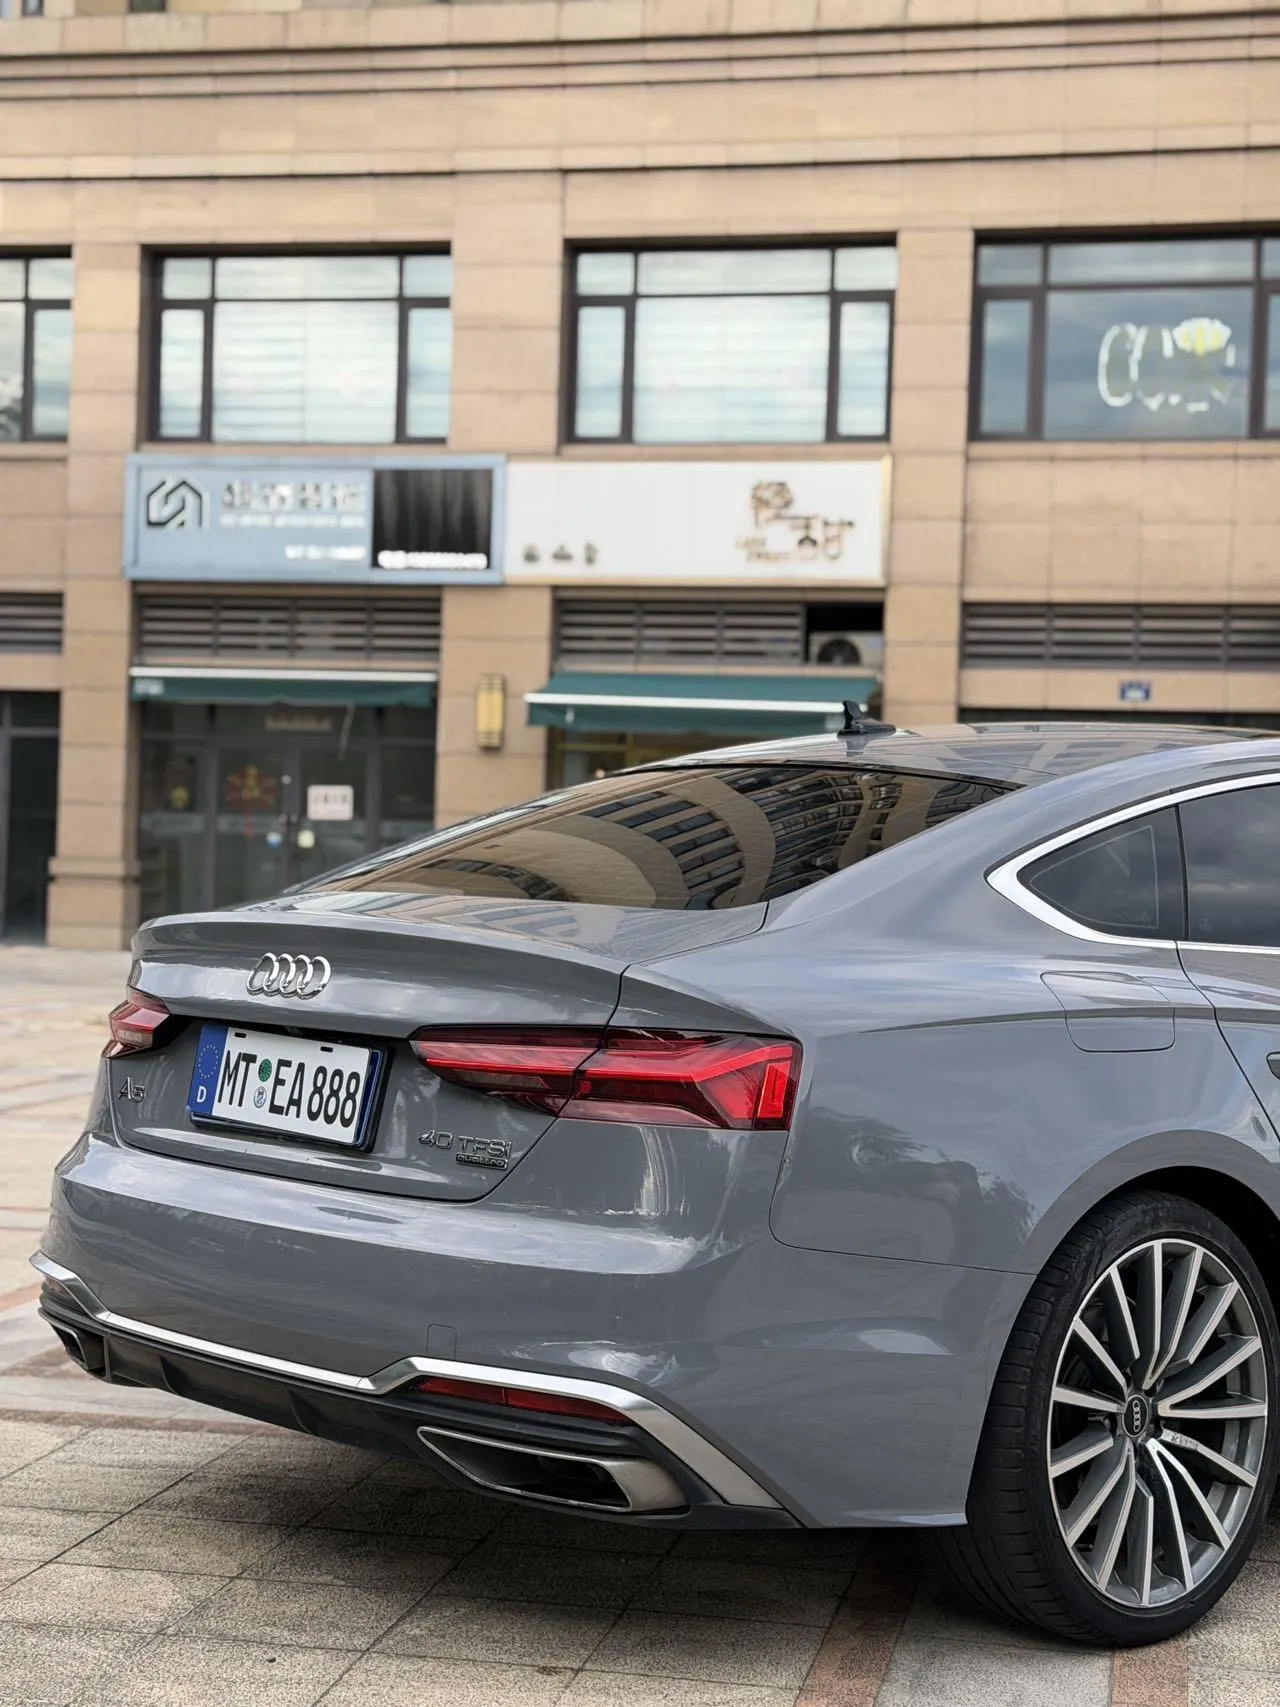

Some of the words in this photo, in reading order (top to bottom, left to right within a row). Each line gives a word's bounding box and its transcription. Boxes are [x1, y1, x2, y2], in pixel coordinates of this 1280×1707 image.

[119, 1077, 145, 1102] A5
[217, 1049, 257, 1107] MT
[196, 1086, 207, 1103] D
[419, 1130, 453, 1149] 40
[457, 1135, 511, 1158] TFSI
[456, 1154, 506, 1168] quattro
